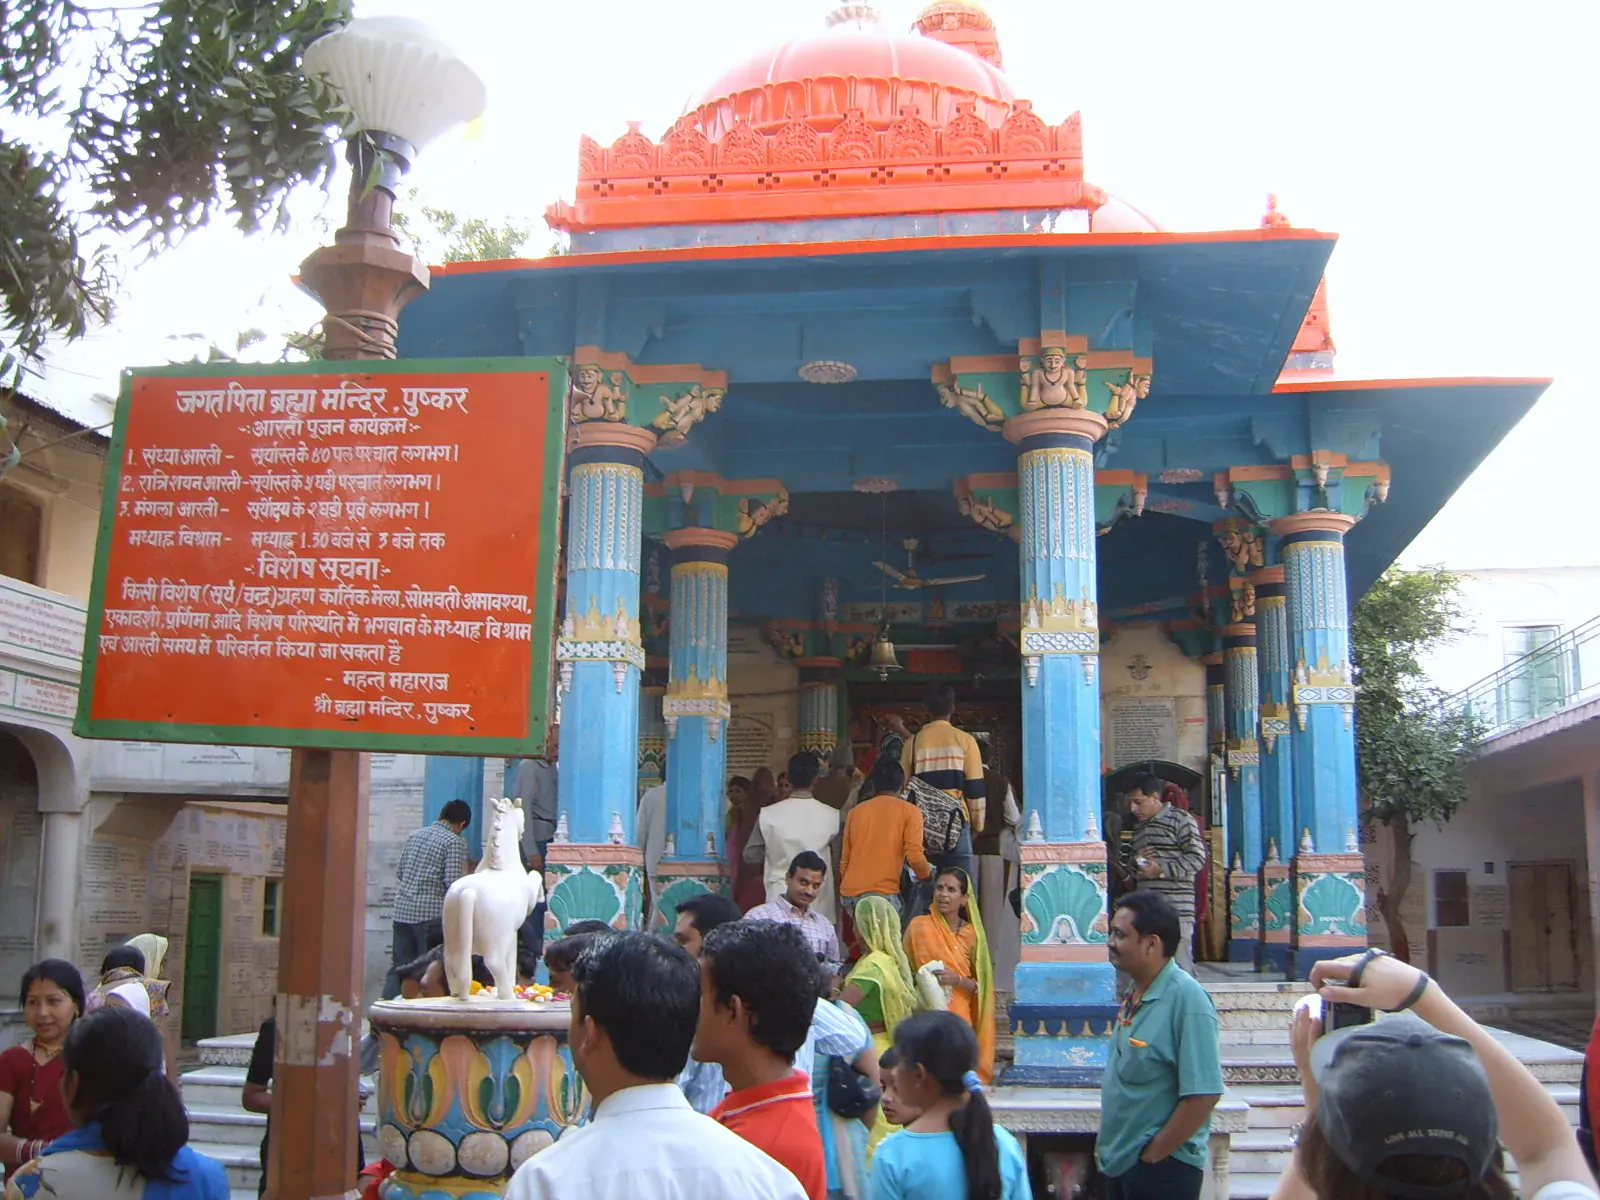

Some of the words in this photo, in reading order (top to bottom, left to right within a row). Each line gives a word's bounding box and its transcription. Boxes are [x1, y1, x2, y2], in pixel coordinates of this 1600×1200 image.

[270, 389, 317, 417] ब्रह्मा
[400, 387, 469, 417] पुष्कर
[307, 419, 345, 442] पूजन
[296, 441, 310, 463] के
[169, 475, 203, 492] शयन
[291, 469, 303, 491] के
[134, 497, 174, 518] मंगला
[291, 496, 306, 518] के
[345, 496, 368, 522] पूर्व
[331, 525, 355, 549] बजे
[356, 526, 373, 551] से
[392, 526, 416, 549] बजे
[419, 532, 446, 552] तक
[122, 576, 160, 603] किसी
[160, 577, 201, 603] विशेष
[319, 583, 370, 609] कार्तिक
[405, 584, 462, 613] सोमवती
[212, 608, 243, 632] आदि
[247, 608, 285, 632] विशेष
[347, 611, 360, 634] में
[363, 616, 418, 636] भगवान
[418, 613, 432, 636] के
[121, 631, 161, 657] आरती
[162, 638, 197, 656] समय
[216, 633, 273, 660] परिवर्तन
[275, 635, 316, 659] किया
[318, 642, 339, 659] जा
[340, 643, 385, 666] सकता
[388, 638, 404, 666] है
[343, 670, 386, 693] महन्त
[389, 672, 450, 694] महाराज
[313, 692, 333, 713] श्री
[335, 699, 367, 719] ब्रह्मा
[423, 703, 475, 724] पुष्कर
[1408, 1128, 1425, 1138] ALL
